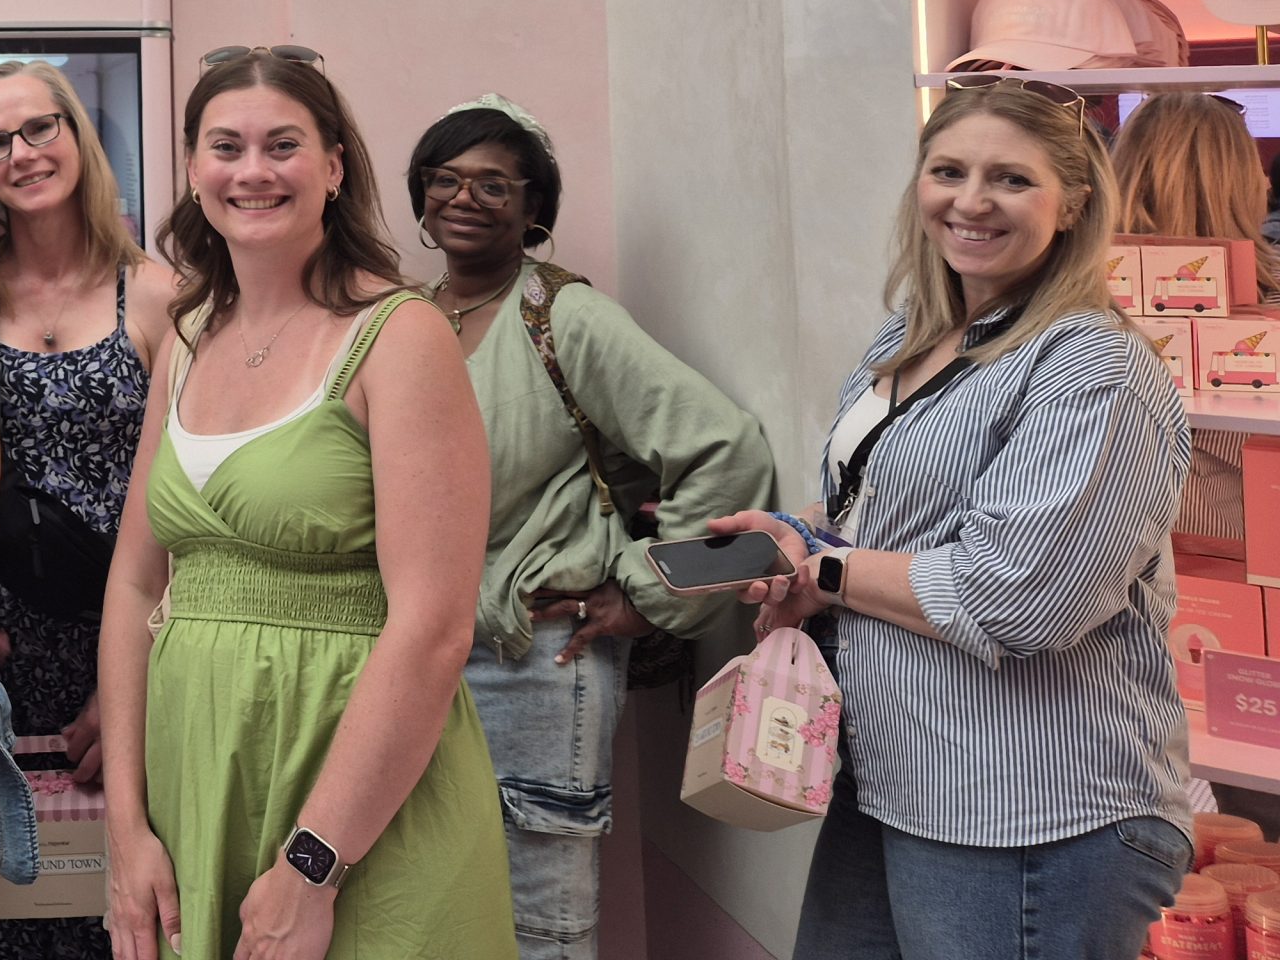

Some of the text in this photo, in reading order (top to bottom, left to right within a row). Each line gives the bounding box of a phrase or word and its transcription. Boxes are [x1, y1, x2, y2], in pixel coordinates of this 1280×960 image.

[1235, 693, 1277, 716] $25
[68, 858, 101, 869] TOWN
[1160, 936, 1224, 951] STATEMENT
